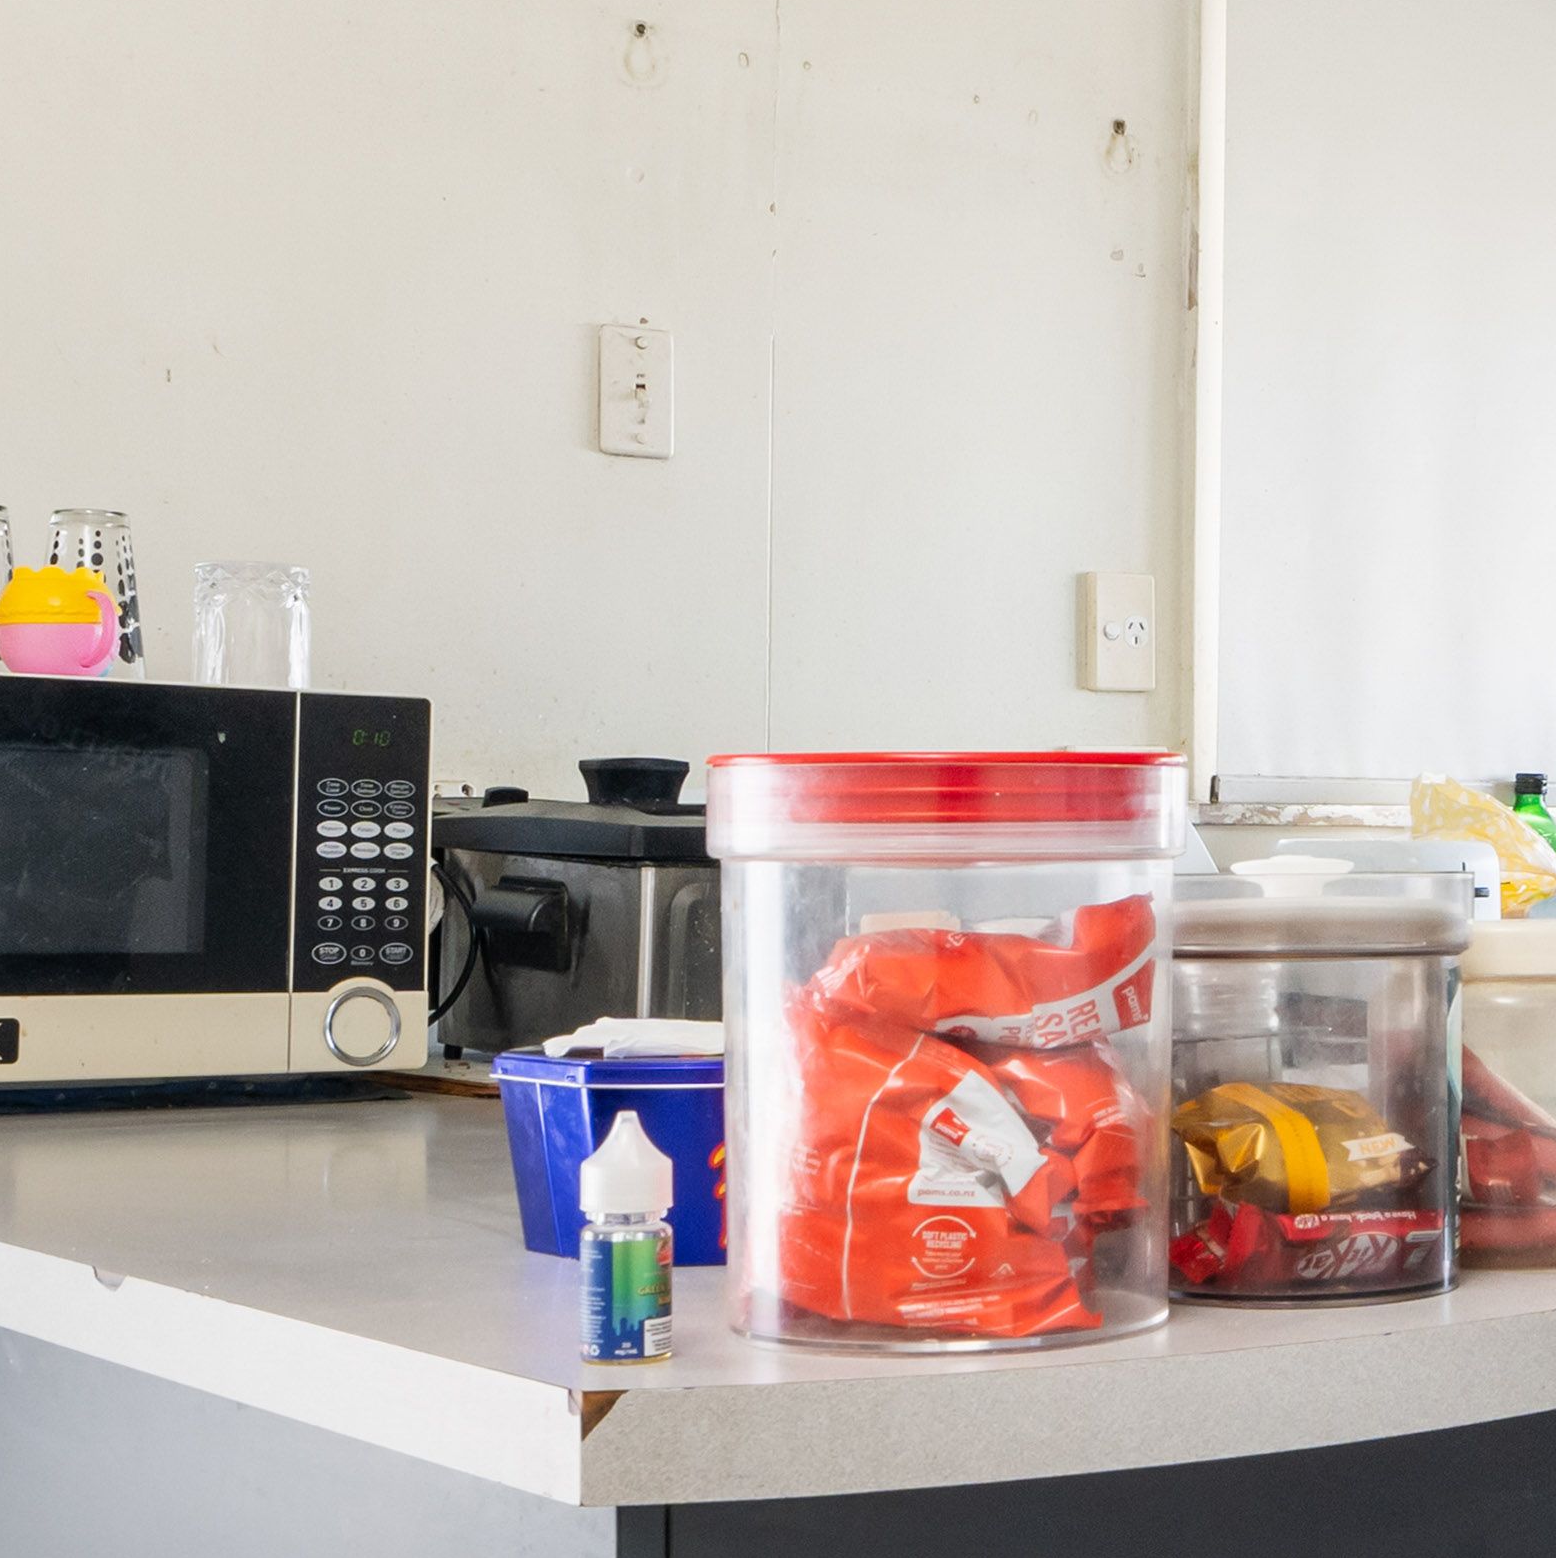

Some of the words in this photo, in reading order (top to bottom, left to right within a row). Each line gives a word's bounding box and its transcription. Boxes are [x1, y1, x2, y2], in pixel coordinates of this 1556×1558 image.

[329, 880, 334, 888] 1
[361, 880, 368, 889] 2
[394, 880, 401, 889] 3
[327, 899, 334, 908] 4
[360, 899, 367, 908] 5
[393, 899, 400, 908] 6
[327, 919, 334, 927] 7
[360, 919, 367, 927] 8
[393, 919, 400, 927] 9
[319, 946, 340, 954] STOP
[359, 948, 366, 957] 0
[1122, 986, 1146, 1022] pams
[917, 1189, 976, 1198] pams.co.nz
